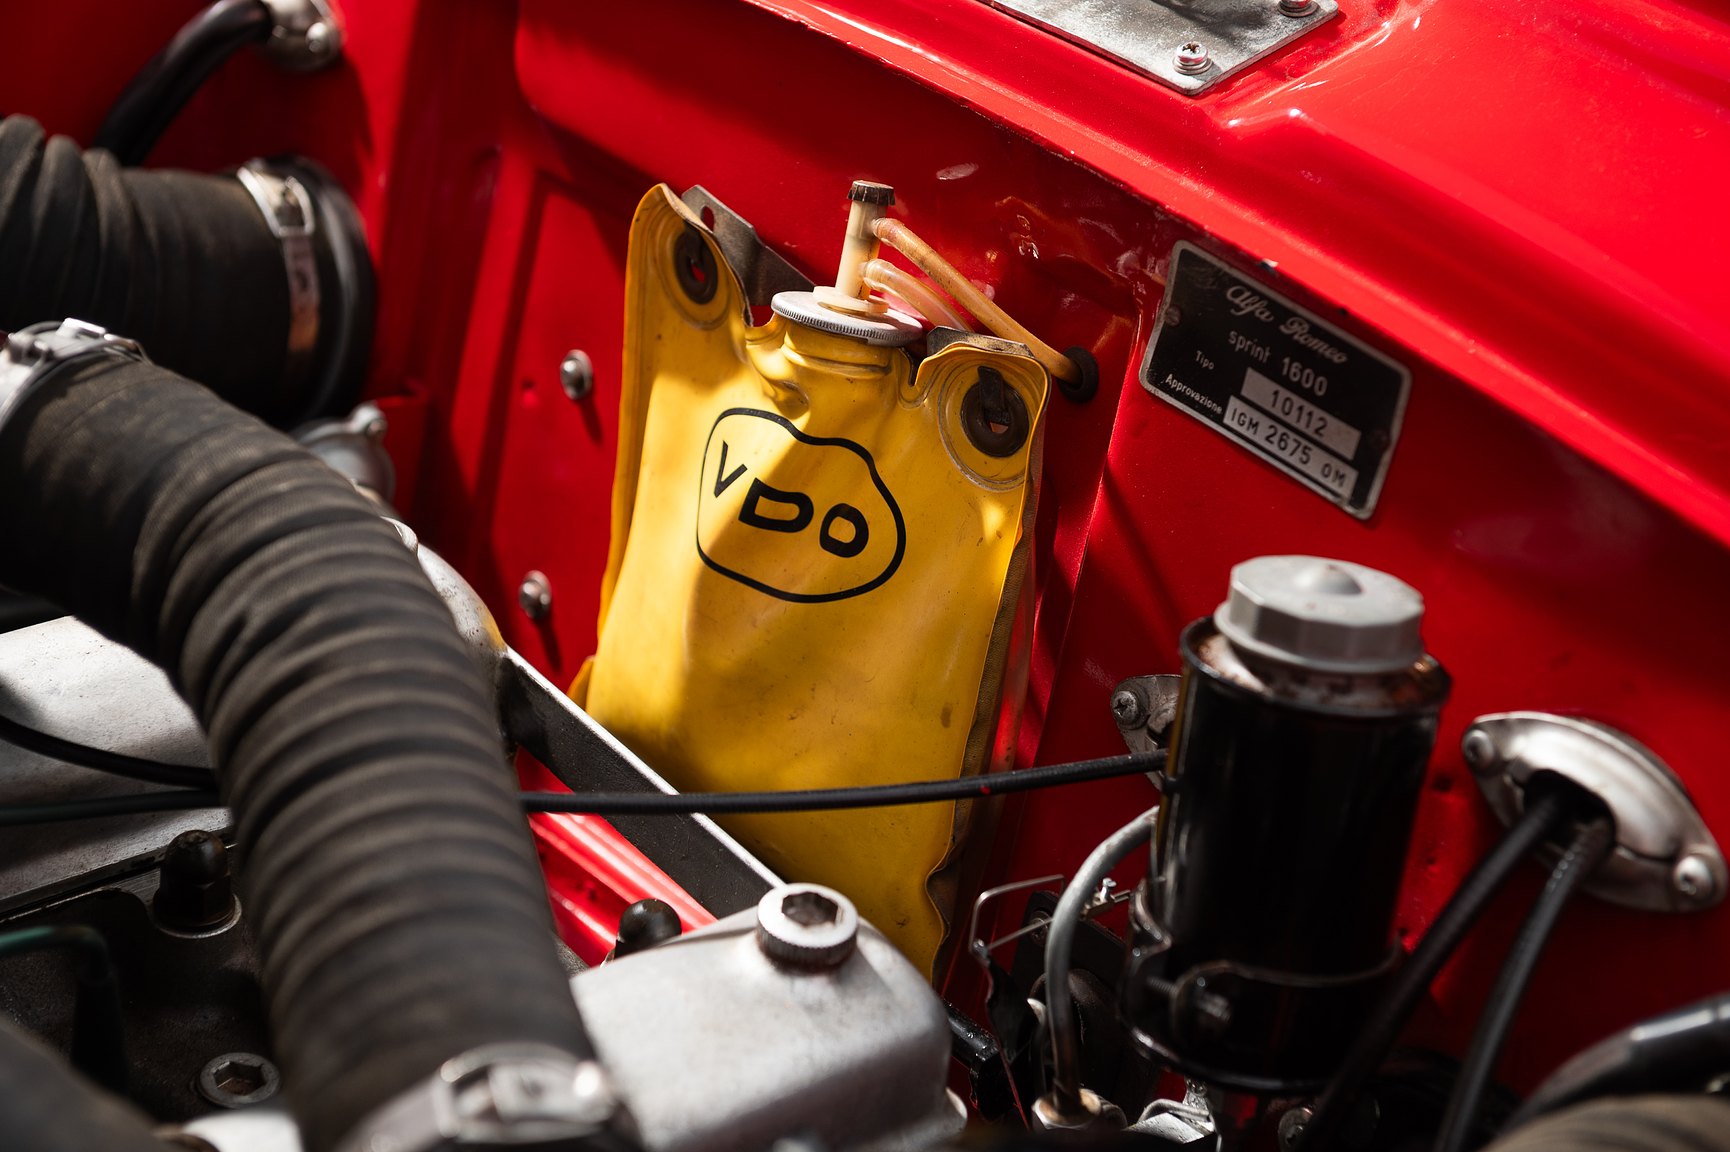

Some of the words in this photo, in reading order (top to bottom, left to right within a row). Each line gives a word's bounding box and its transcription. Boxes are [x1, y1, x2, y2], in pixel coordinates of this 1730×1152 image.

[1226, 285, 1274, 323] Alfa
[1279, 316, 1348, 364] Romeo
[1228, 330, 1271, 364] sprint
[1281, 356, 1328, 397] 1600
[1165, 373, 1223, 414] Approvazione
[1230, 407, 1260, 435] IGM
[1264, 425, 1312, 465] 2675
[1195, 350, 1215, 370] Tipo
[1271, 389, 1328, 438] 10112
[714, 440, 869, 558] VDO
